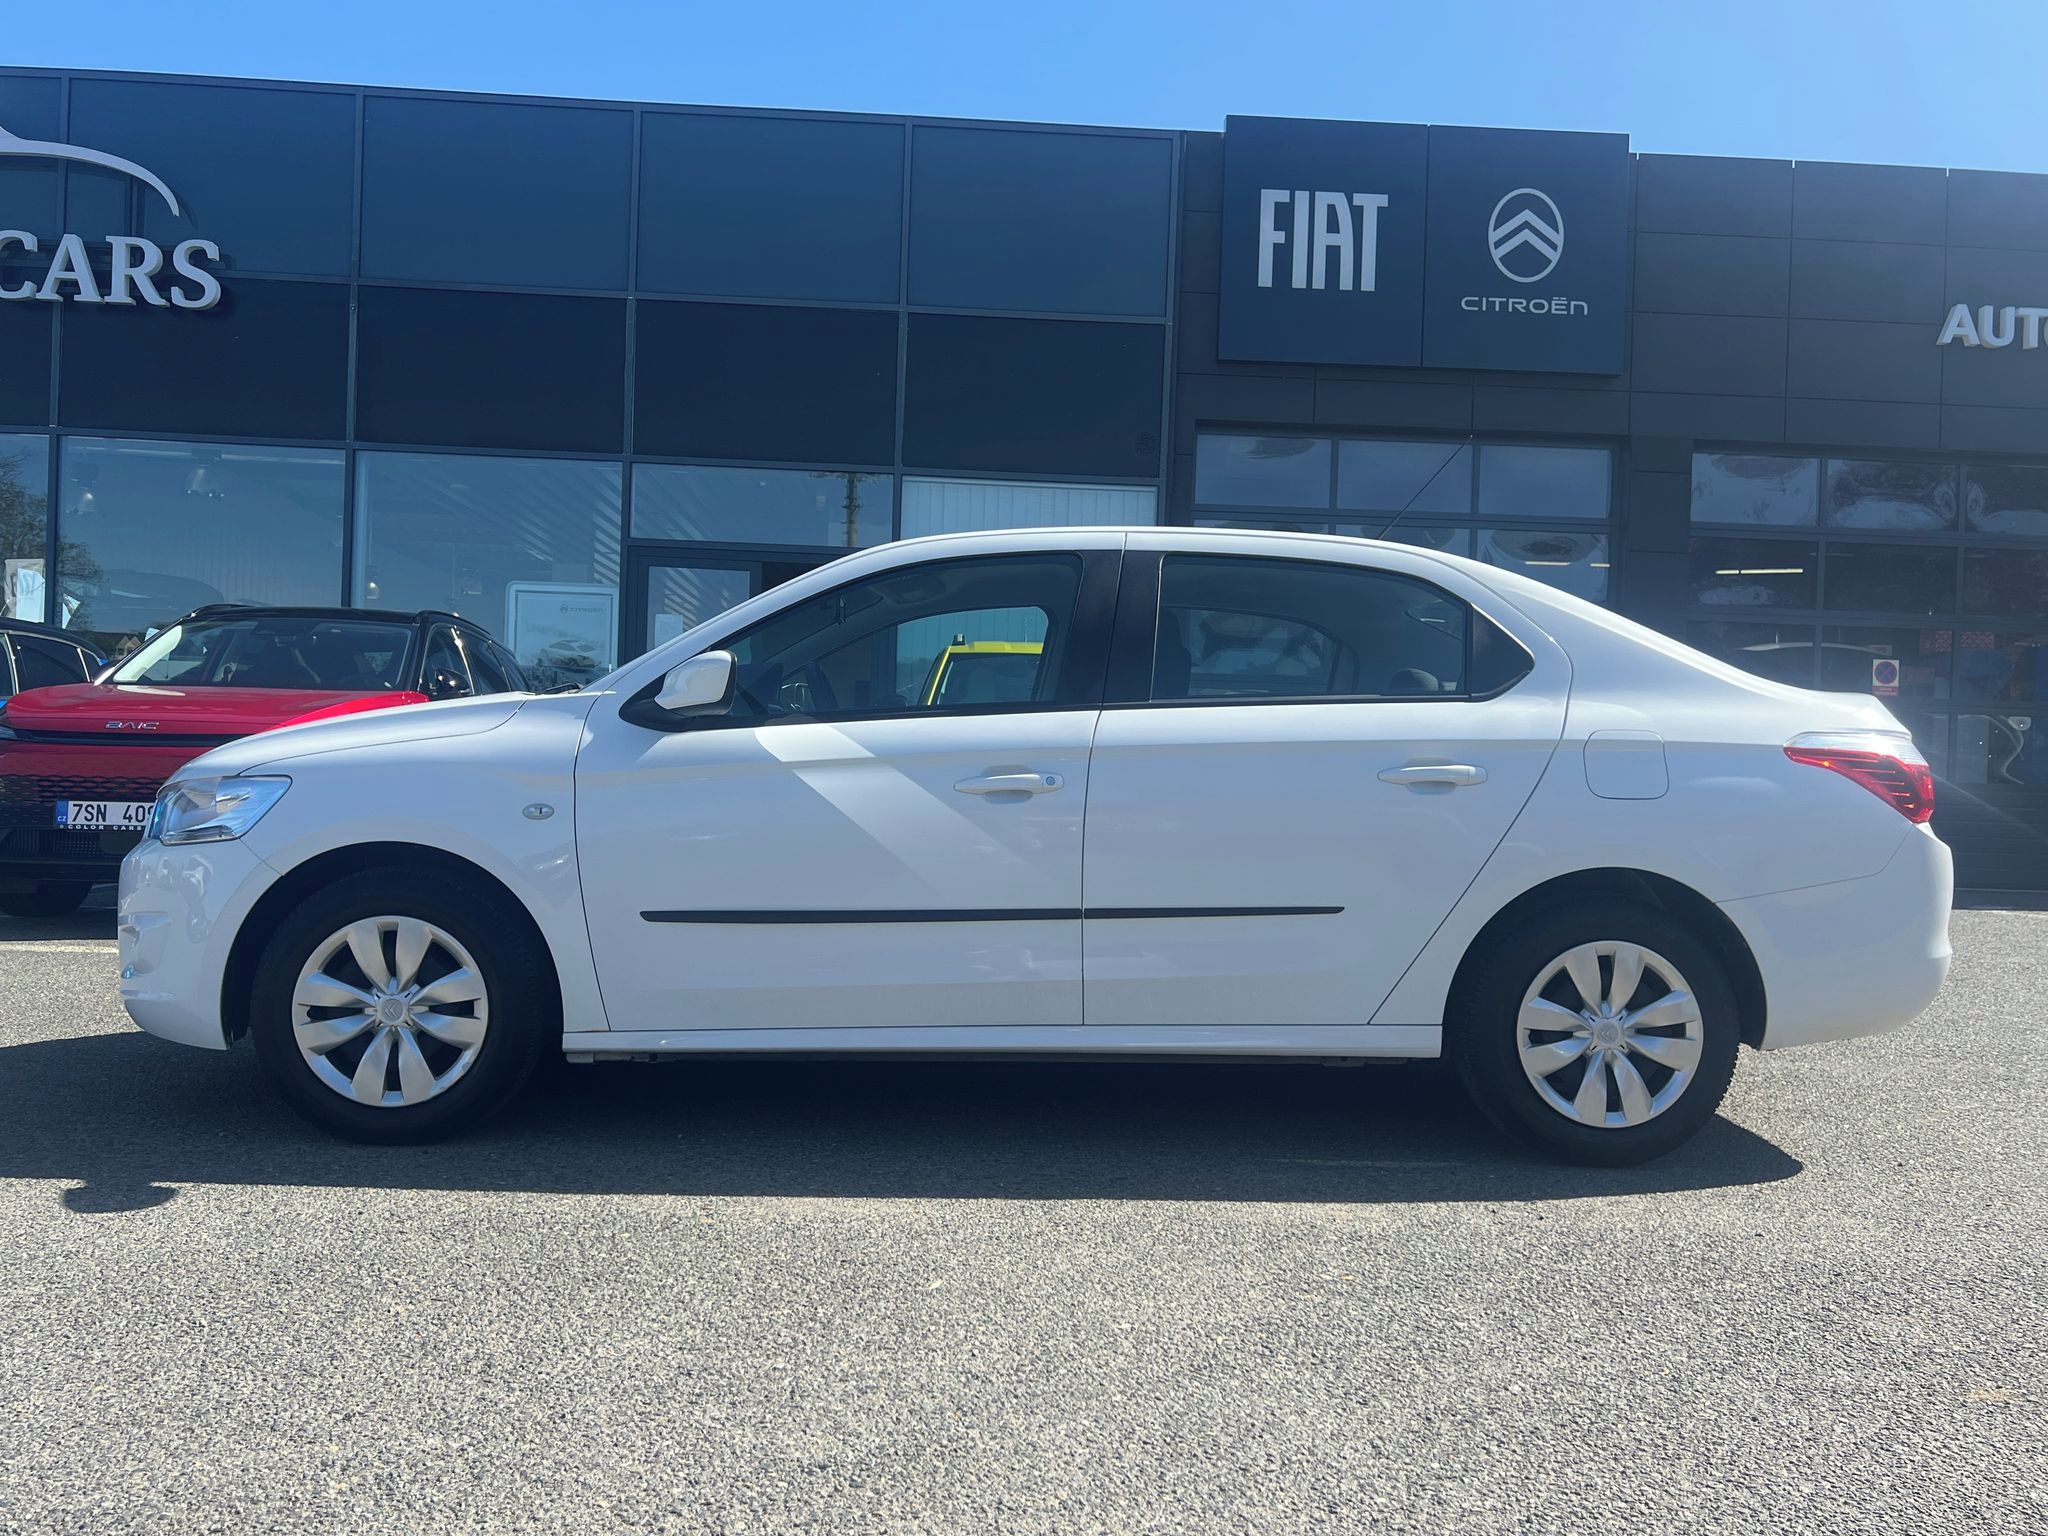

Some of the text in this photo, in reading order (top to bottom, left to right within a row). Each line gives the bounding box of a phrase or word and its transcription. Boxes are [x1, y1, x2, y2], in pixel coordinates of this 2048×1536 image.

[0, 229, 222, 310] CARS
[1257, 188, 1389, 292] FIAT
[1936, 303, 2048, 350] AUT
[72, 803, 107, 823] 7SN
